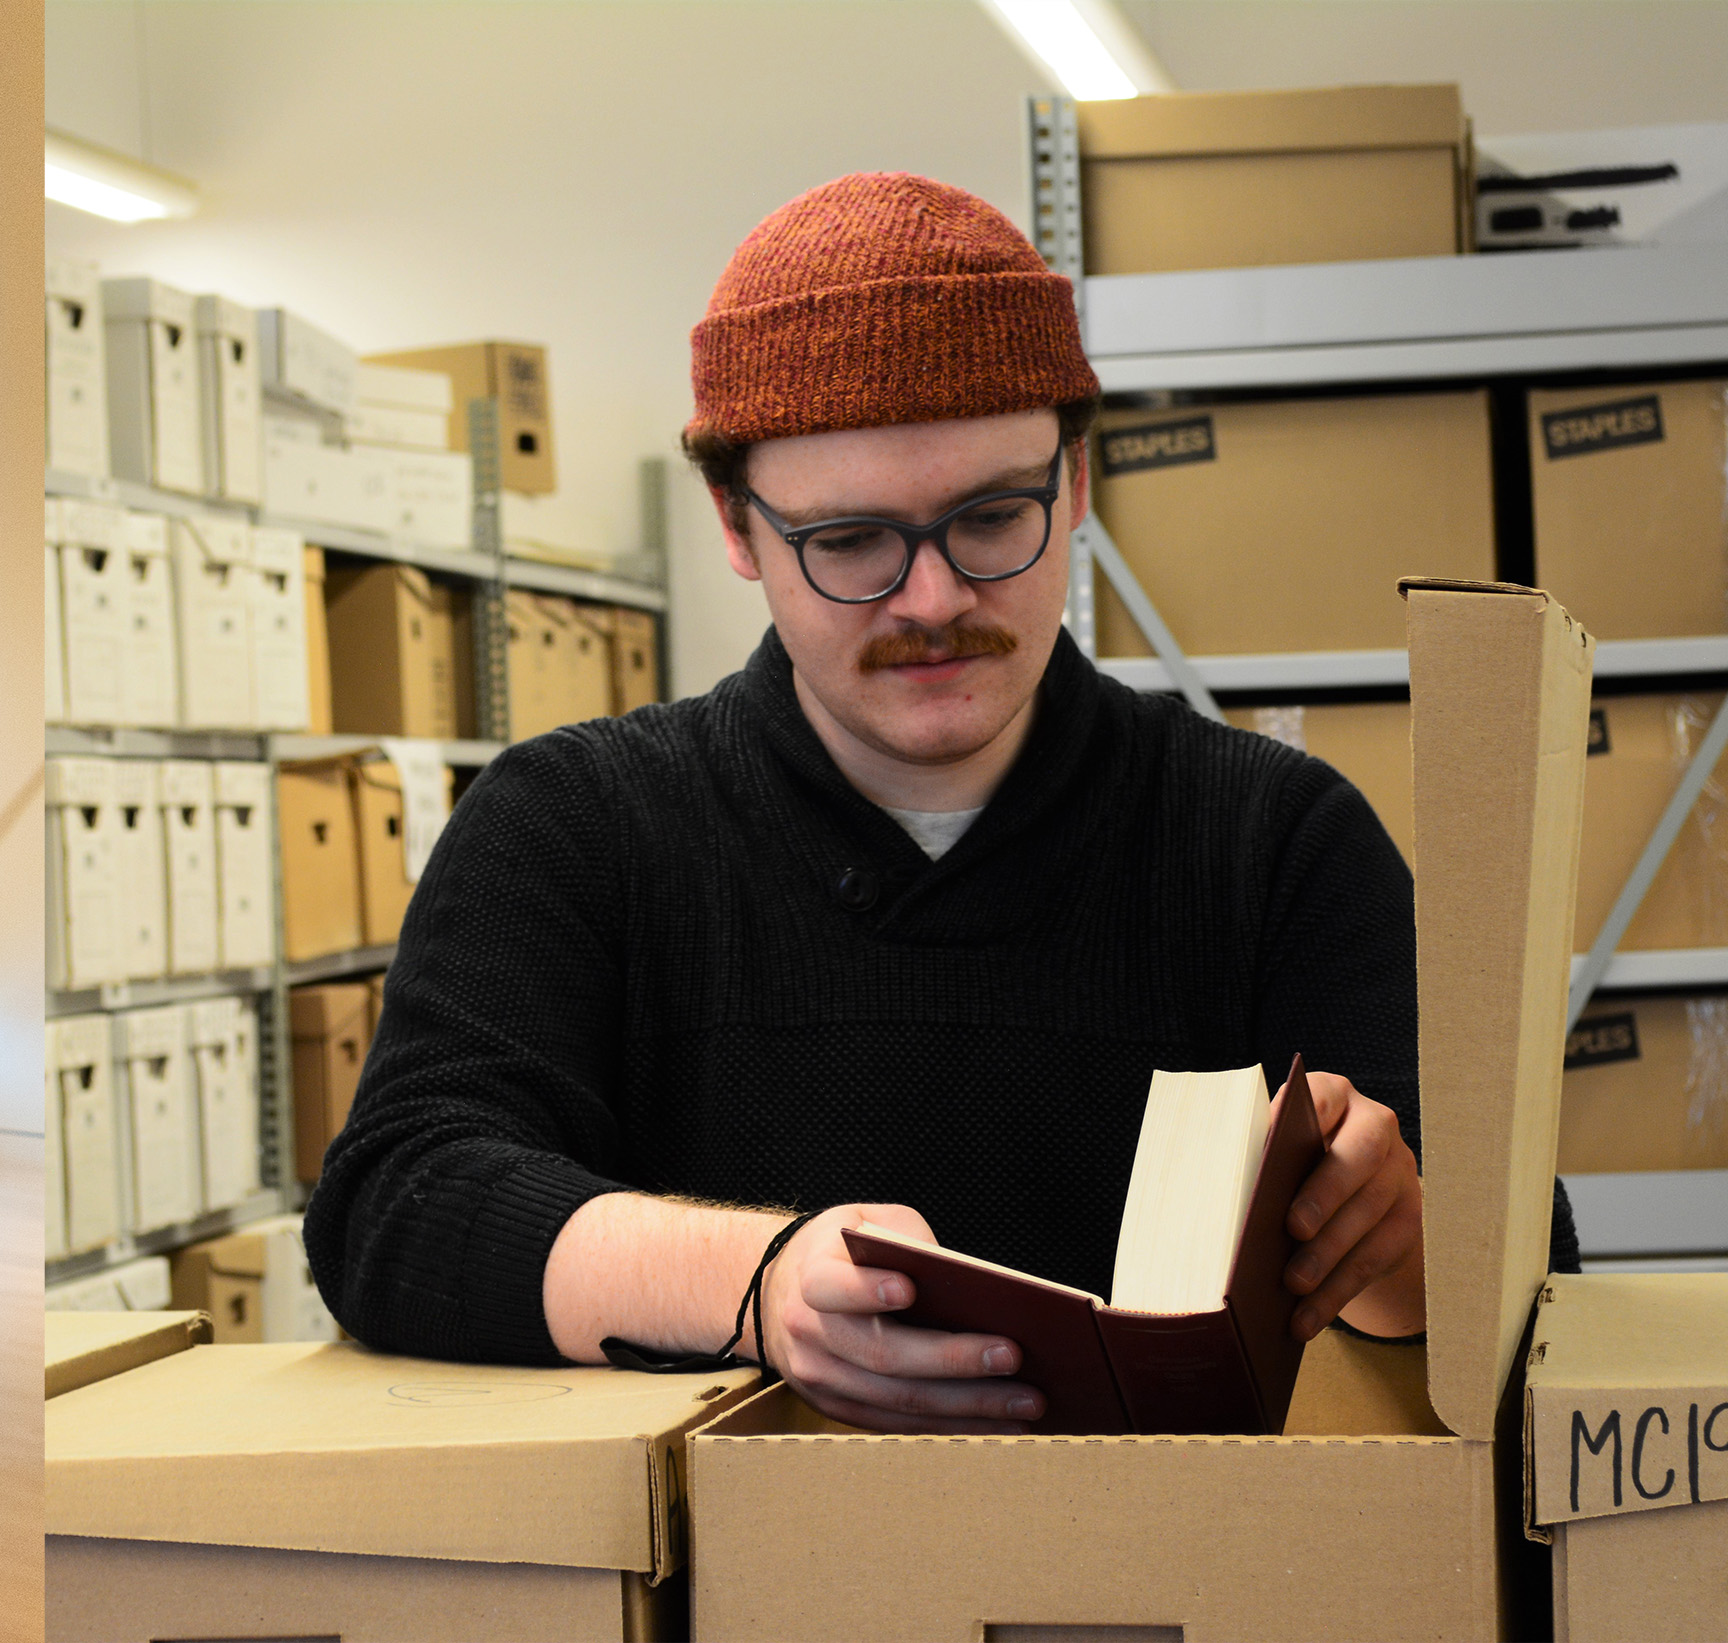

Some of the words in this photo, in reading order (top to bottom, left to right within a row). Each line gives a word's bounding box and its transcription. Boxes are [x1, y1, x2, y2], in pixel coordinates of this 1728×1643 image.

[1104, 424, 1211, 465] STAPLES
[1546, 404, 1658, 447] STAPLES
[1565, 1024, 1631, 1056] PLES
